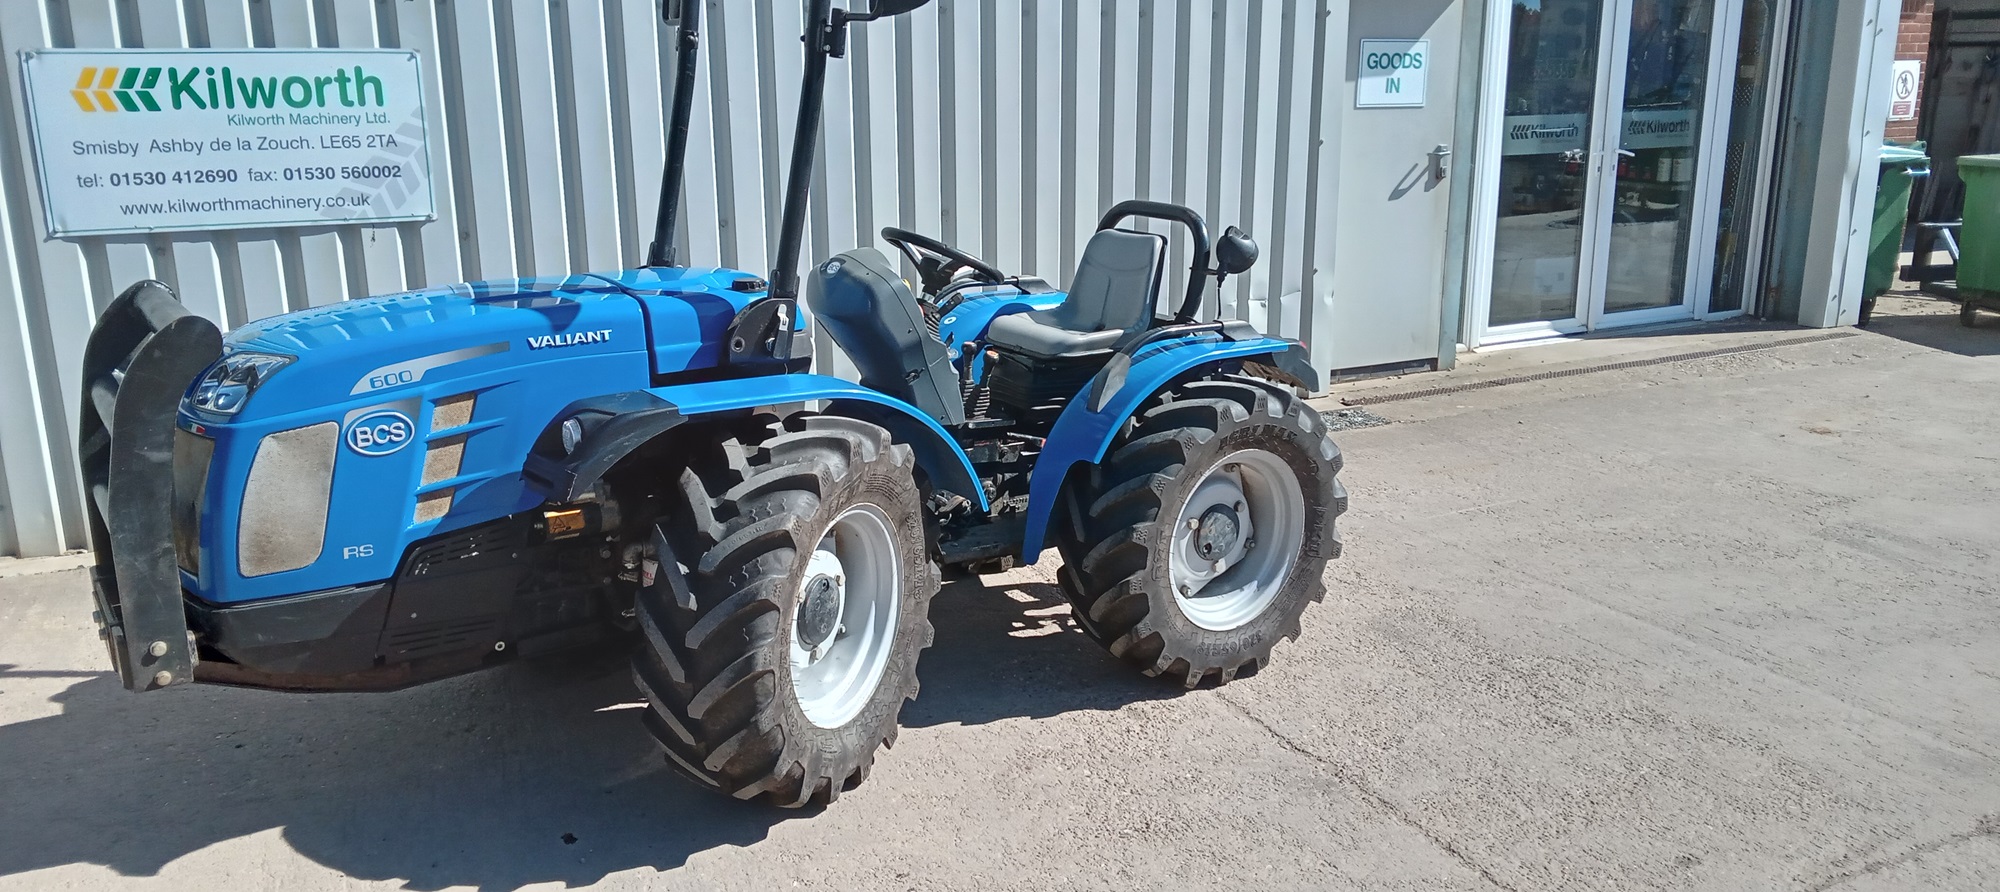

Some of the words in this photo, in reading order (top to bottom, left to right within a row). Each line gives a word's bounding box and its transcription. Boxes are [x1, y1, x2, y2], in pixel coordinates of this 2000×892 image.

[1366, 52, 1423, 70] GOODS
[168, 65, 384, 110] Kilworth
[1385, 78, 1401, 94] IN
[227, 113, 285, 126] Kilworth
[289, 112, 361, 127] Machinery
[365, 111, 391, 124] Ltd.
[1646, 119, 1691, 134] Kilworth
[72, 139, 139, 157] Smisby
[149, 138, 204, 156] Ashby
[209, 137, 232, 151] de
[237, 137, 252, 151] la
[256, 136, 315, 151] Zouch.
[320, 134, 362, 149] LE65
[366, 134, 398, 148] 2TA
[76, 173, 104, 188] tel:
[109, 171, 166, 187] 01530
[172, 169, 238, 184] 412690
[247, 167, 278, 182] fax:
[283, 166, 336, 181] 01530
[341, 165, 402, 180] 560002
[119, 193, 371, 216] www.kilworthmachinery.co.uk
[527, 329, 613, 350] VALIANT
[369, 369, 413, 389] 600
[354, 422, 407, 448] BCS
[343, 543, 374, 560] RS
